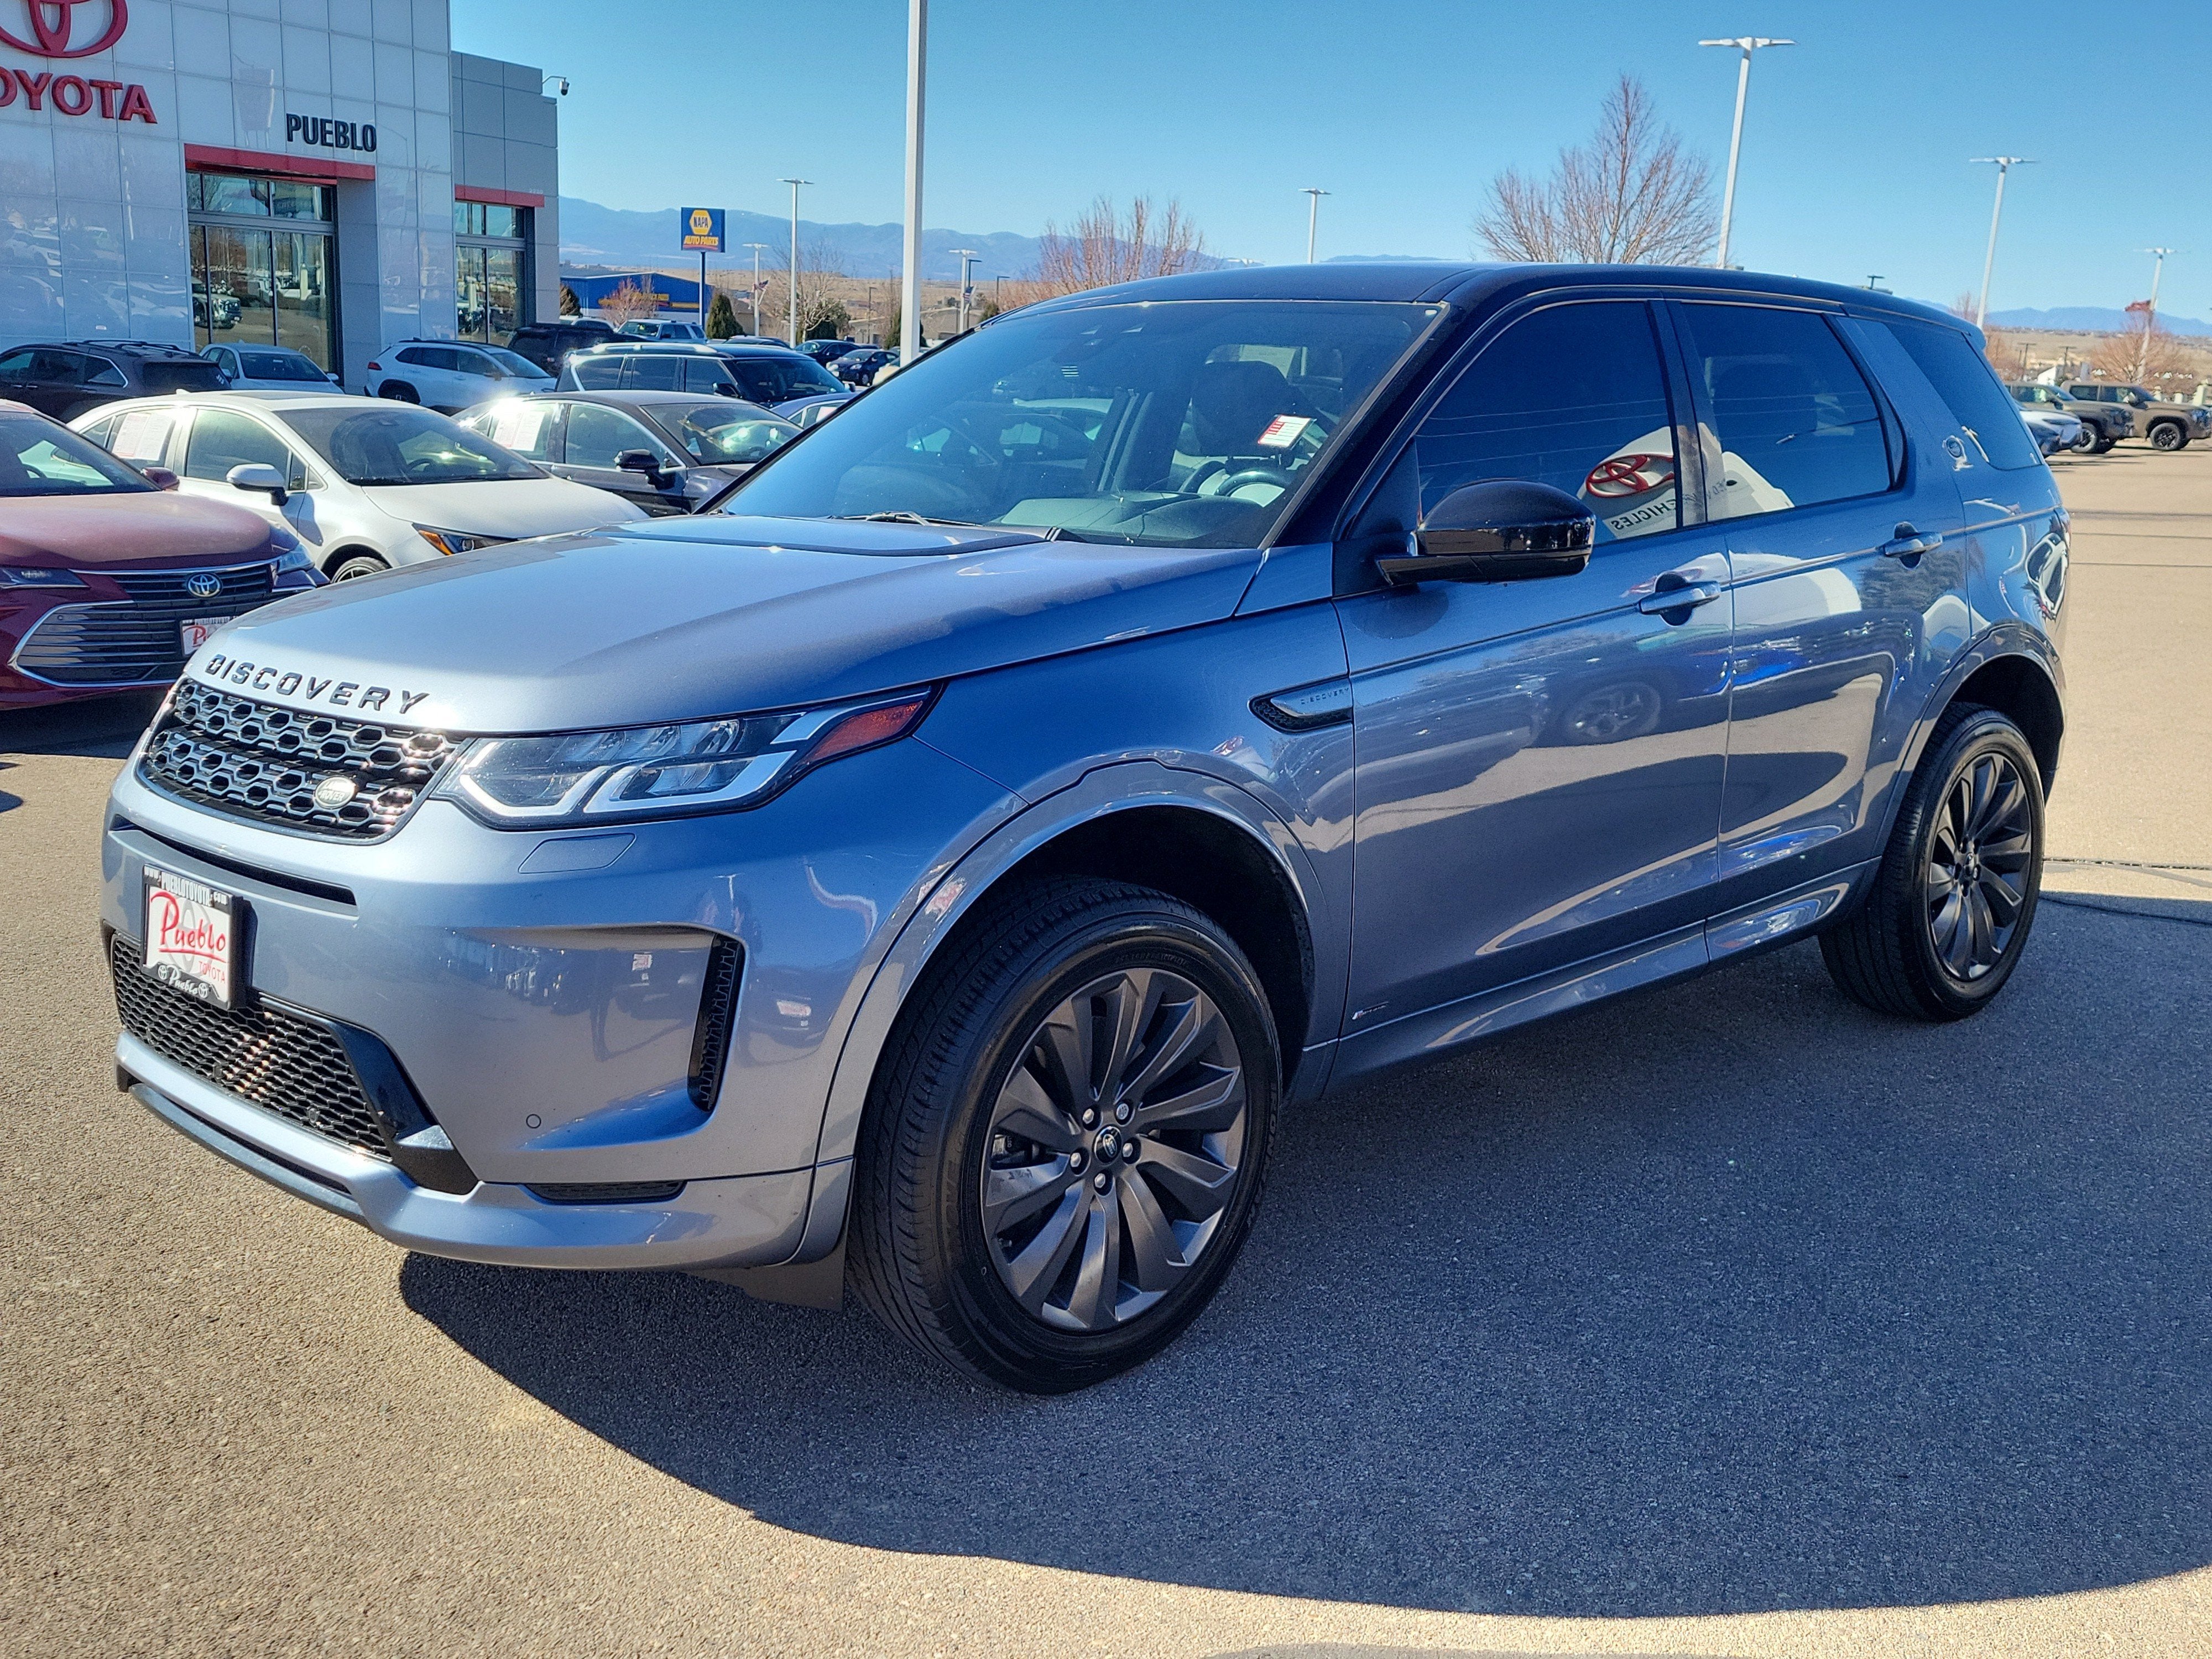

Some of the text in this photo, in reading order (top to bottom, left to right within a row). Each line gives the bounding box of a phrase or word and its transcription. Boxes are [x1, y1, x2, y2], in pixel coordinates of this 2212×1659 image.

[286, 113, 377, 152] PUEBLO
[693, 216, 708, 228] NAPA
[684, 235, 718, 246] AUTO PARTS
[204, 654, 430, 714] DISCOVERY
[150, 890, 226, 952] Pueblo
[167, 964, 198, 995] Pueblo
[199, 961, 226, 984] TOYOTA
